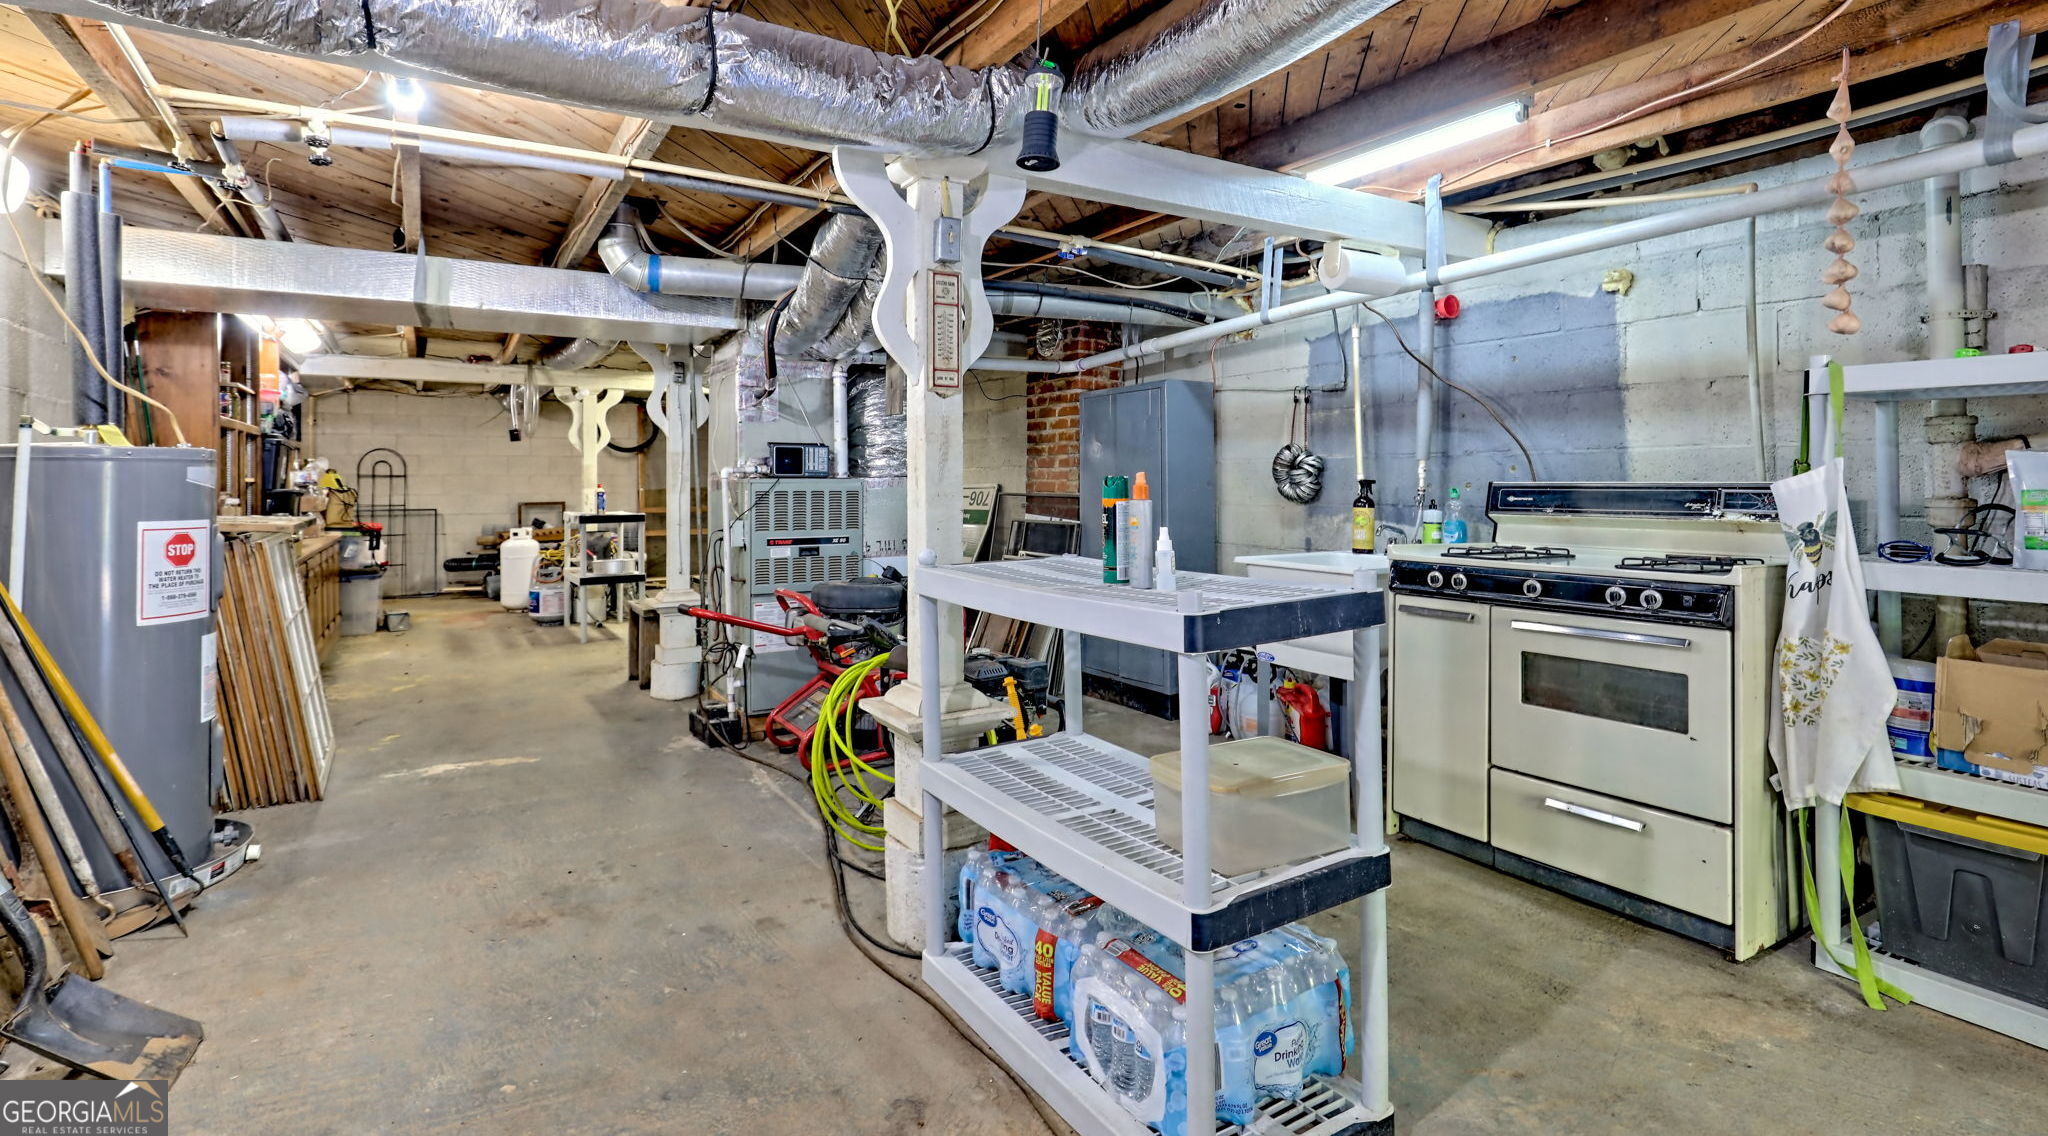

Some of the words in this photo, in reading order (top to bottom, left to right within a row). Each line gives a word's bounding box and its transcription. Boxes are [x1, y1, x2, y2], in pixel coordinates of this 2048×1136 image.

[167, 543, 194, 556] STOP
[1035, 940, 1054, 957] 40
[1136, 963, 1162, 985] VALUE
[1042, 972, 1052, 1005] VALUE
[1254, 1035, 1272, 1050] Great
